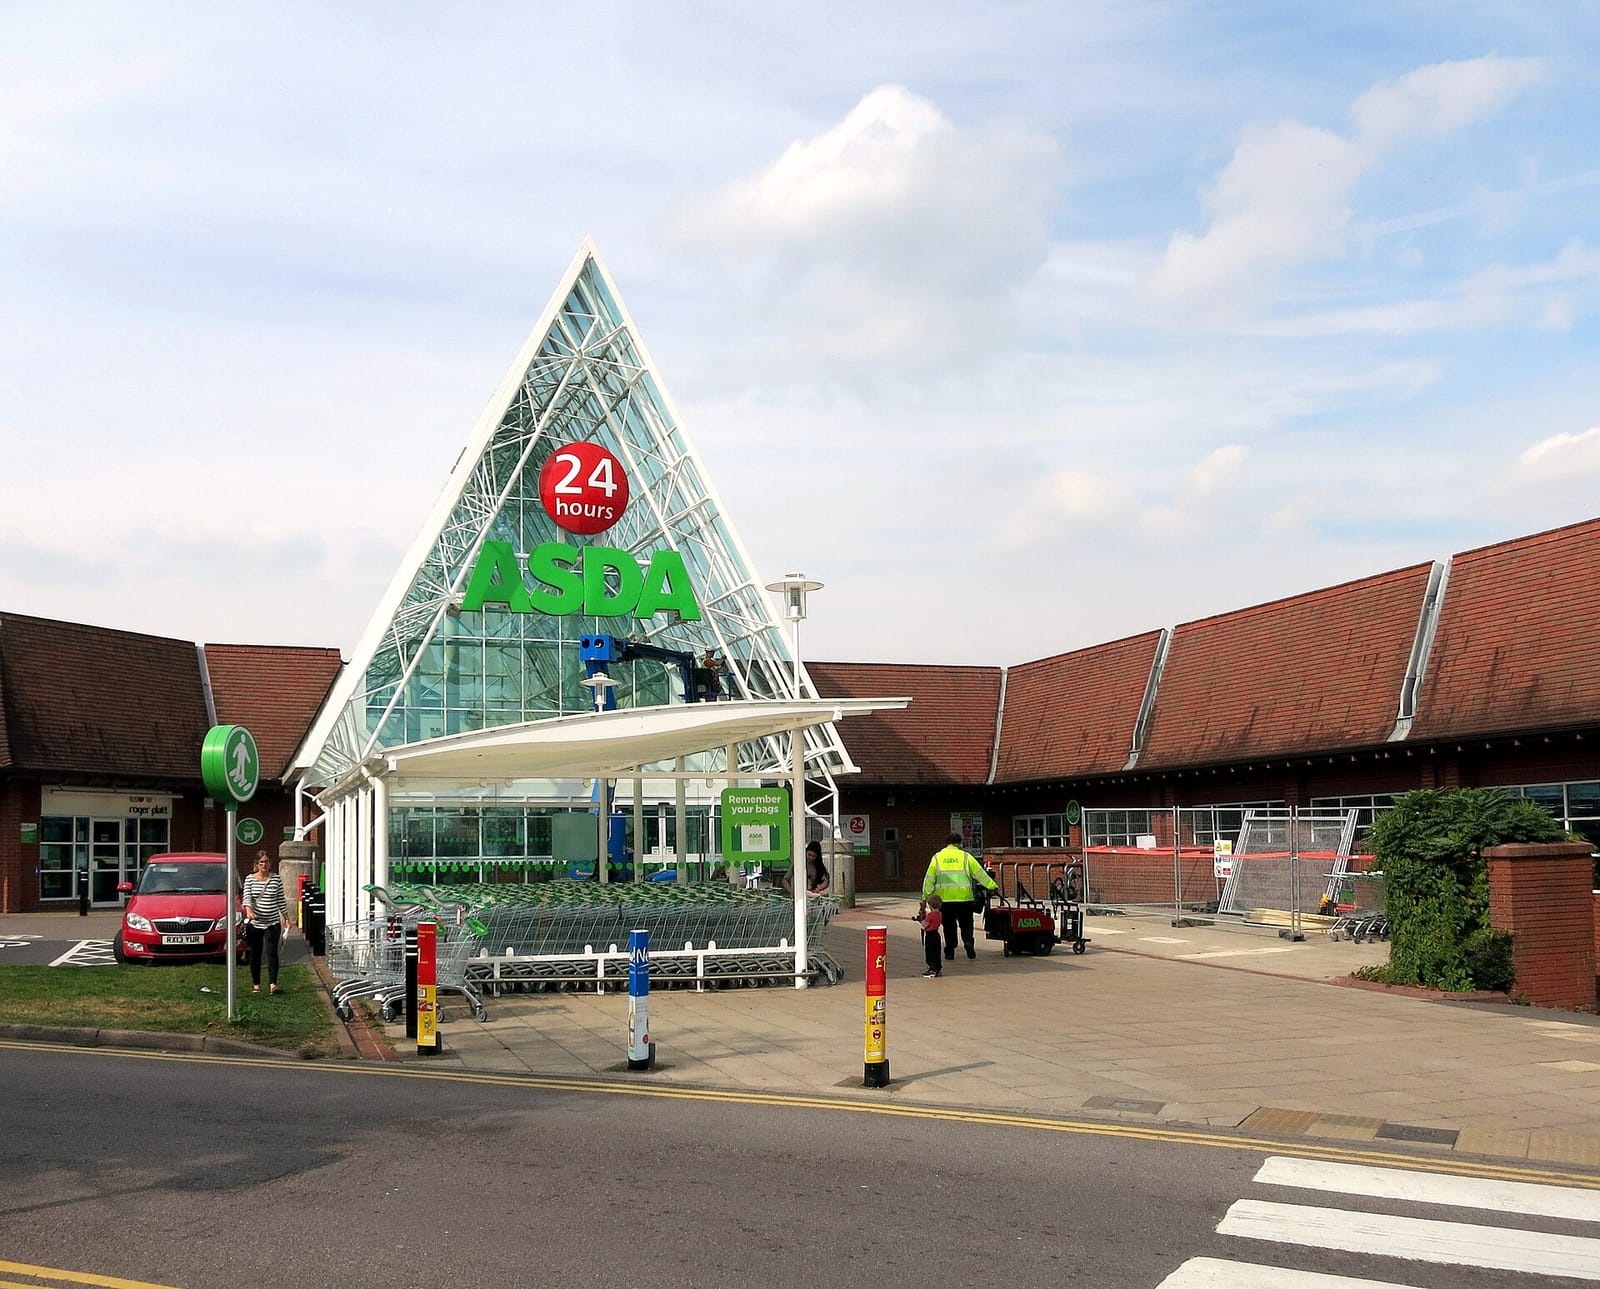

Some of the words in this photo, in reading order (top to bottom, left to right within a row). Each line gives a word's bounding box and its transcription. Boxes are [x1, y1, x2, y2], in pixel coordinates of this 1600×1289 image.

[554, 453, 618, 498] 24
[556, 497, 614, 520] hours
[460, 540, 702, 621] ASDA
[728, 795, 781, 804] Remember
[128, 806, 151, 817] roger
[151, 804, 168, 817] platt
[731, 806, 754, 815] your
[755, 805, 779, 815] bags
[851, 819, 864, 829] 24
[1018, 918, 1041, 928] ASDA
